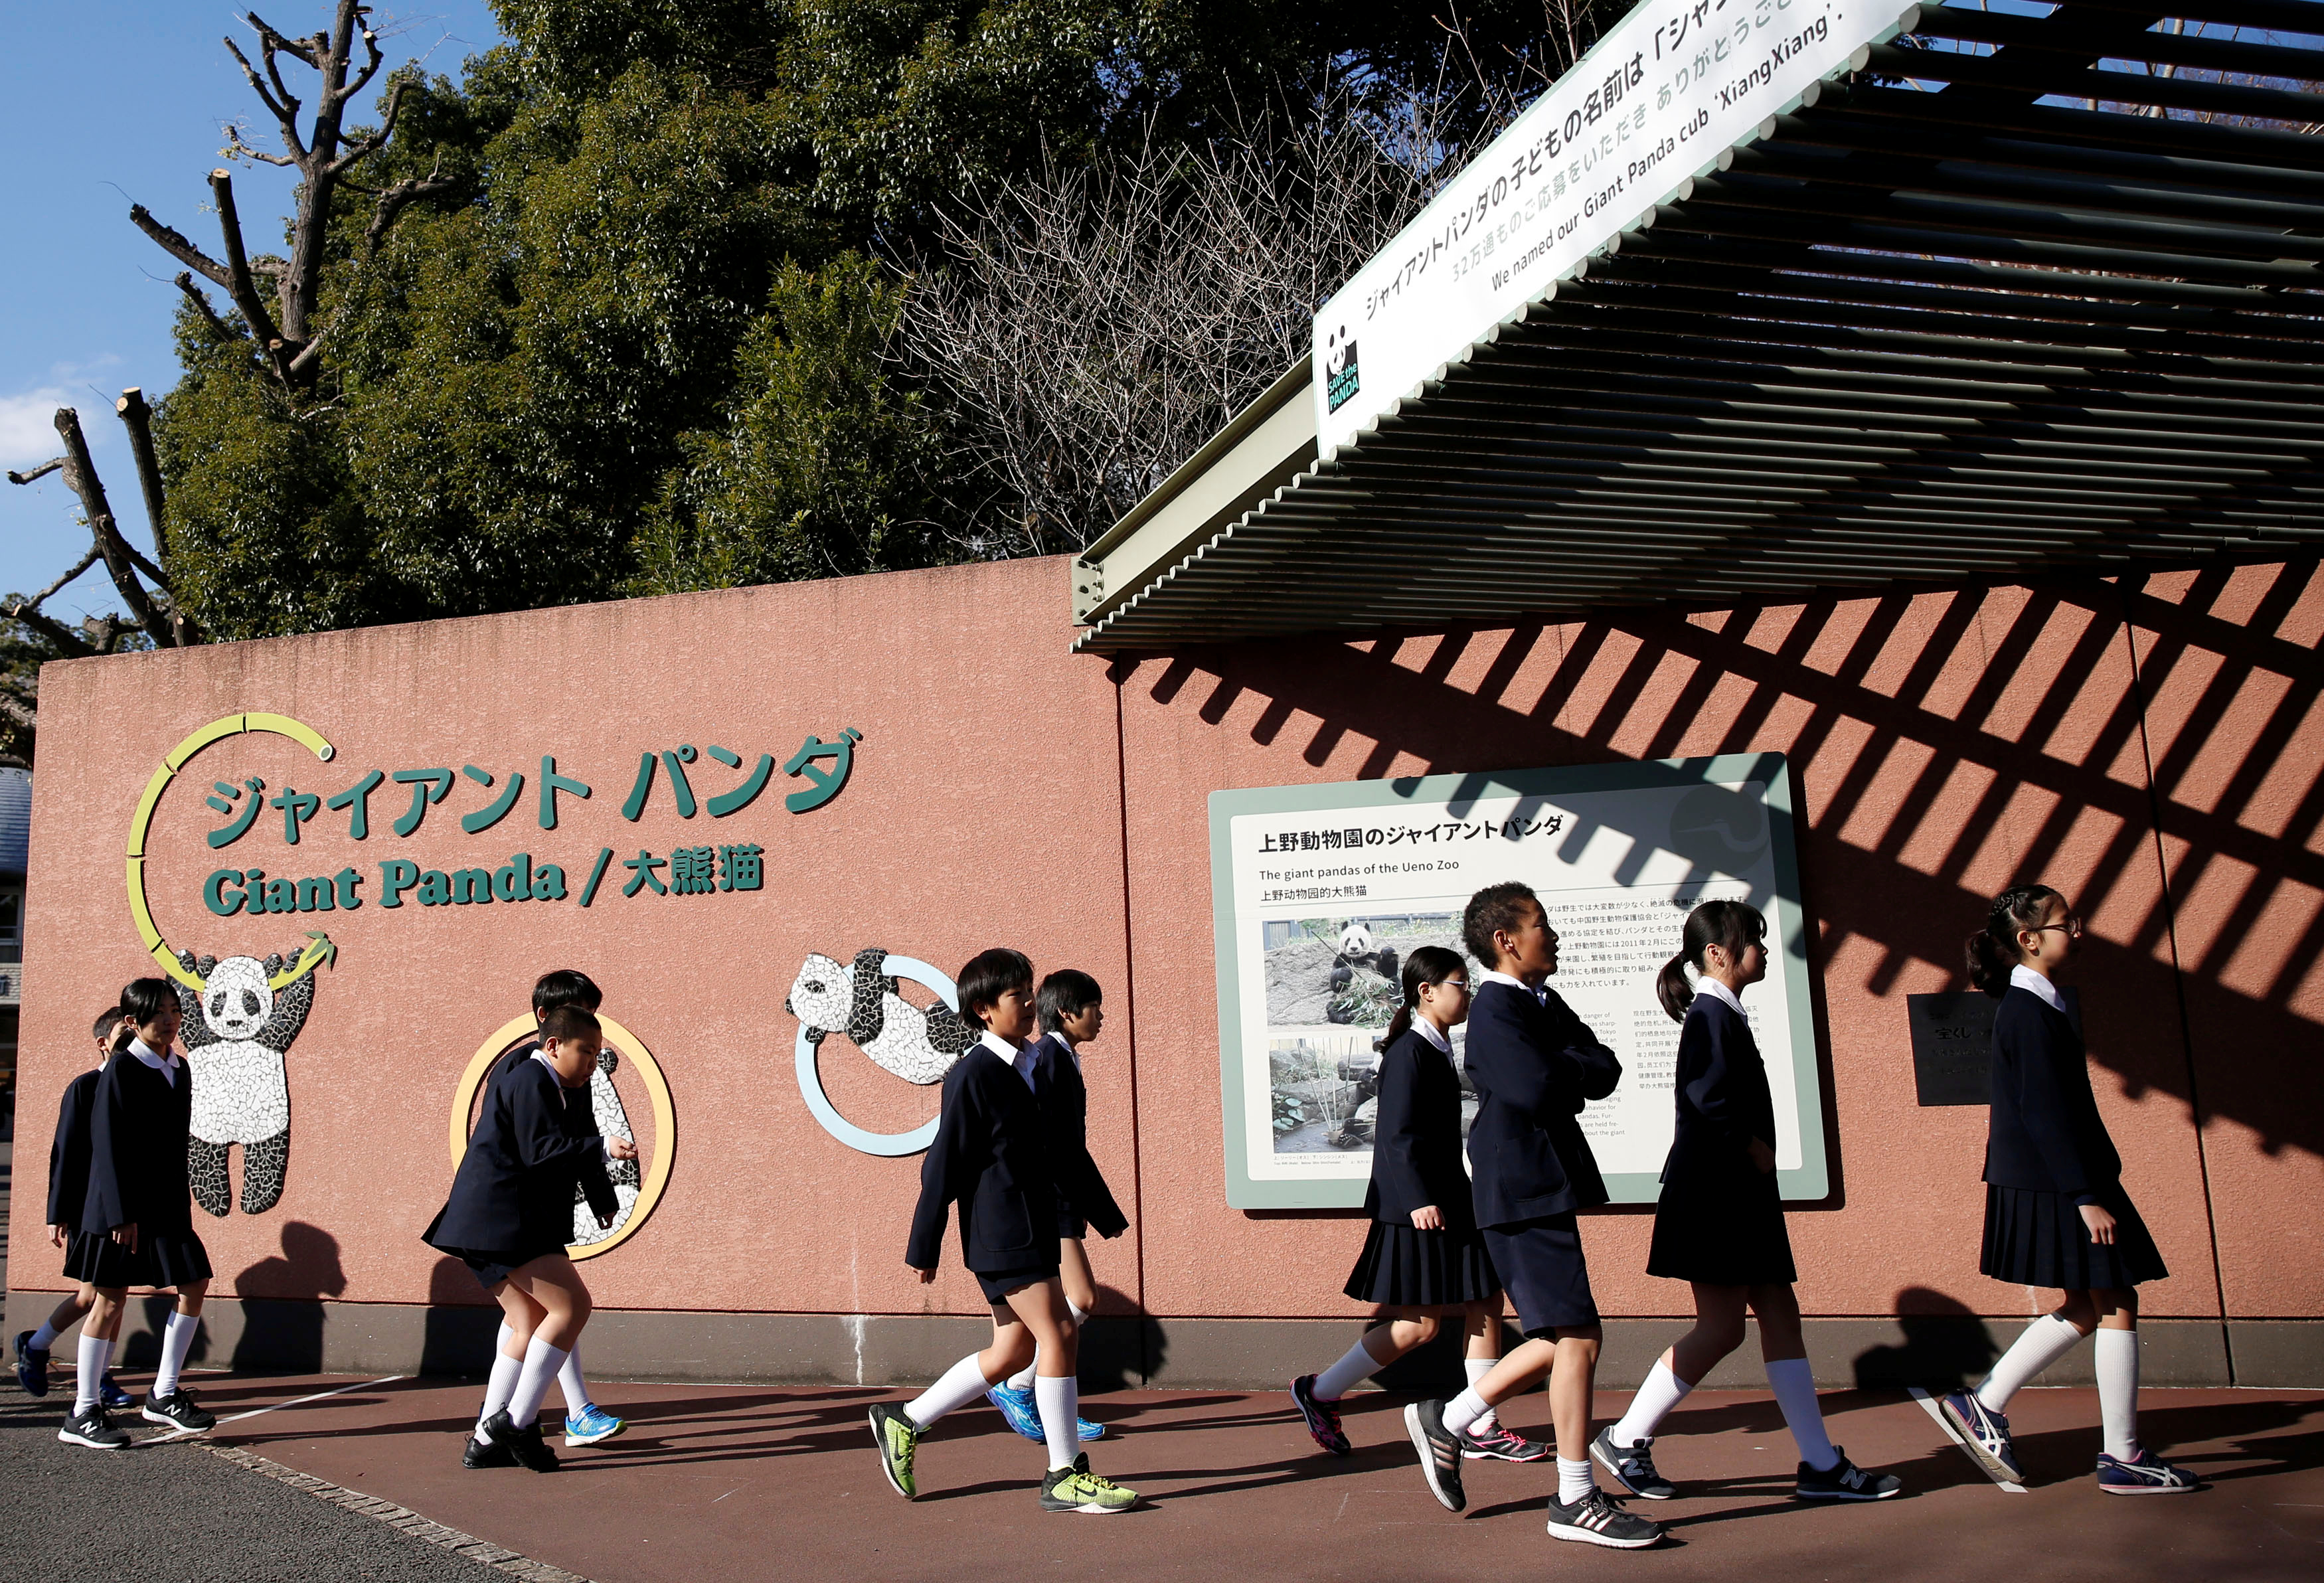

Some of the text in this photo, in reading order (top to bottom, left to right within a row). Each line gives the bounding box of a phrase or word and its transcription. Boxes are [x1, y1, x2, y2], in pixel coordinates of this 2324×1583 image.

[1491, 271, 1509, 292] We
[1513, 236, 1554, 272] named
[1557, 215, 1579, 240] our
[1584, 175, 1623, 218] Giant
[1628, 136, 1675, 185] Panda
[1680, 108, 1708, 143] cub
[1329, 363, 1357, 394] SAVE the
[1329, 375, 1359, 412] PANDA
[207, 728, 863, 849] ジャイアント パンダ
[1258, 814, 1564, 854] 上野動物園のジャイアントパンダ
[202, 868, 363, 916] Giant
[378, 853, 570, 908] Panda
[623, 843, 763, 898] 大熊猫
[1260, 860, 1459, 882] The giant pandas of the Ueno Zoo
[1260, 885, 1367, 902] 上野动物园的大熊猫
